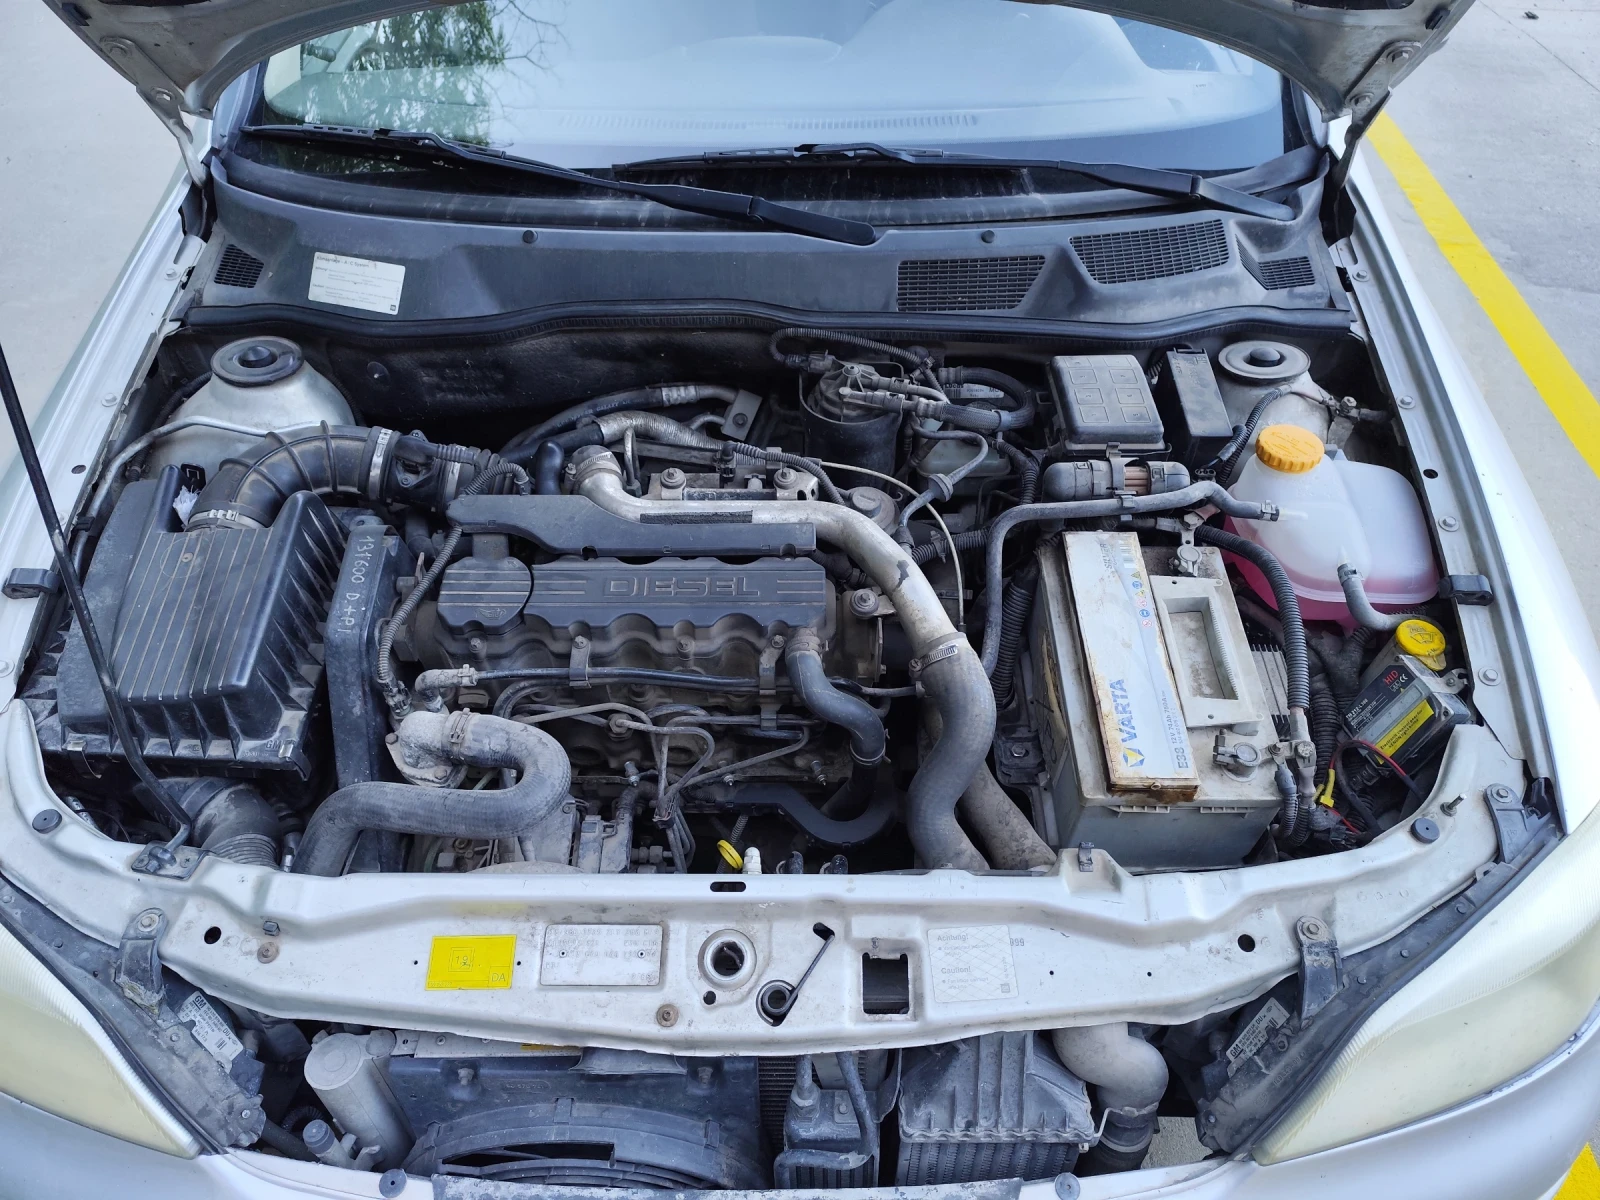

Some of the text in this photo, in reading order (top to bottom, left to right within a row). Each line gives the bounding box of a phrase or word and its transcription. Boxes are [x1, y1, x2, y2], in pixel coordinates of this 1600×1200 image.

[603, 576, 760, 598] DIESEL
[1384, 670, 1399, 686] HID
[1109, 679, 1137, 742] VARTA
[1174, 746, 1189, 769] E38
[941, 966, 971, 974] Caution!
[491, 973, 506, 982] DA
[194, 996, 207, 1008] GM
[1230, 1044, 1240, 1057] GM
